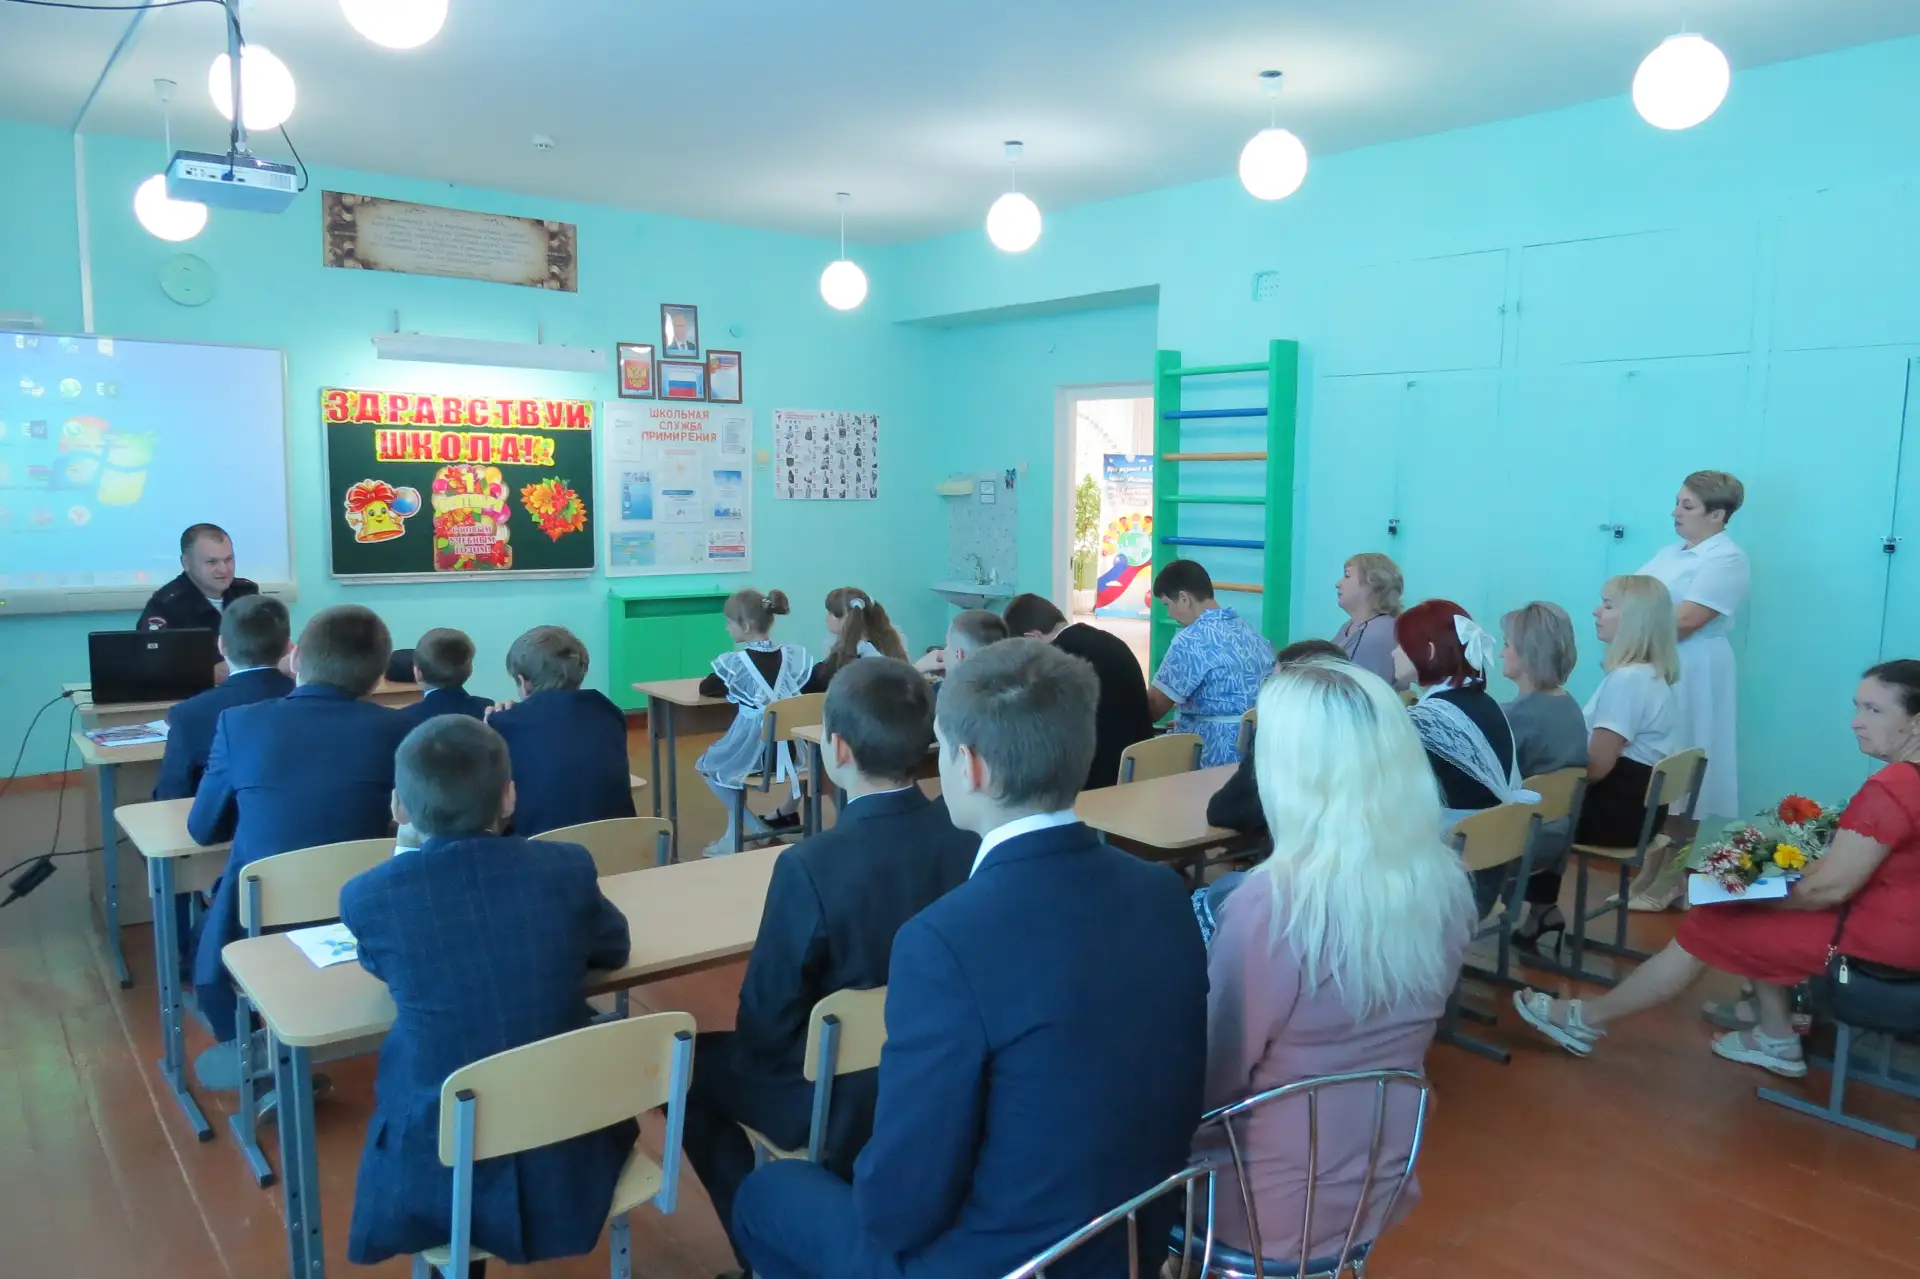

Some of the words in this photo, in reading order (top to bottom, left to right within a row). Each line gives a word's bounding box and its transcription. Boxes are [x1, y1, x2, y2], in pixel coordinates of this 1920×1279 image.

[327, 391, 590, 428] ЗДРАВСТВУЙ
[649, 408, 709, 420] ШКОЛЬНАЯ
[659, 421, 703, 432] СЛУЖБА
[641, 431, 717, 441] ПРИМИРЕНИЯ
[379, 431, 533, 463] ШКОЛА!
[462, 472, 475, 493] 1
